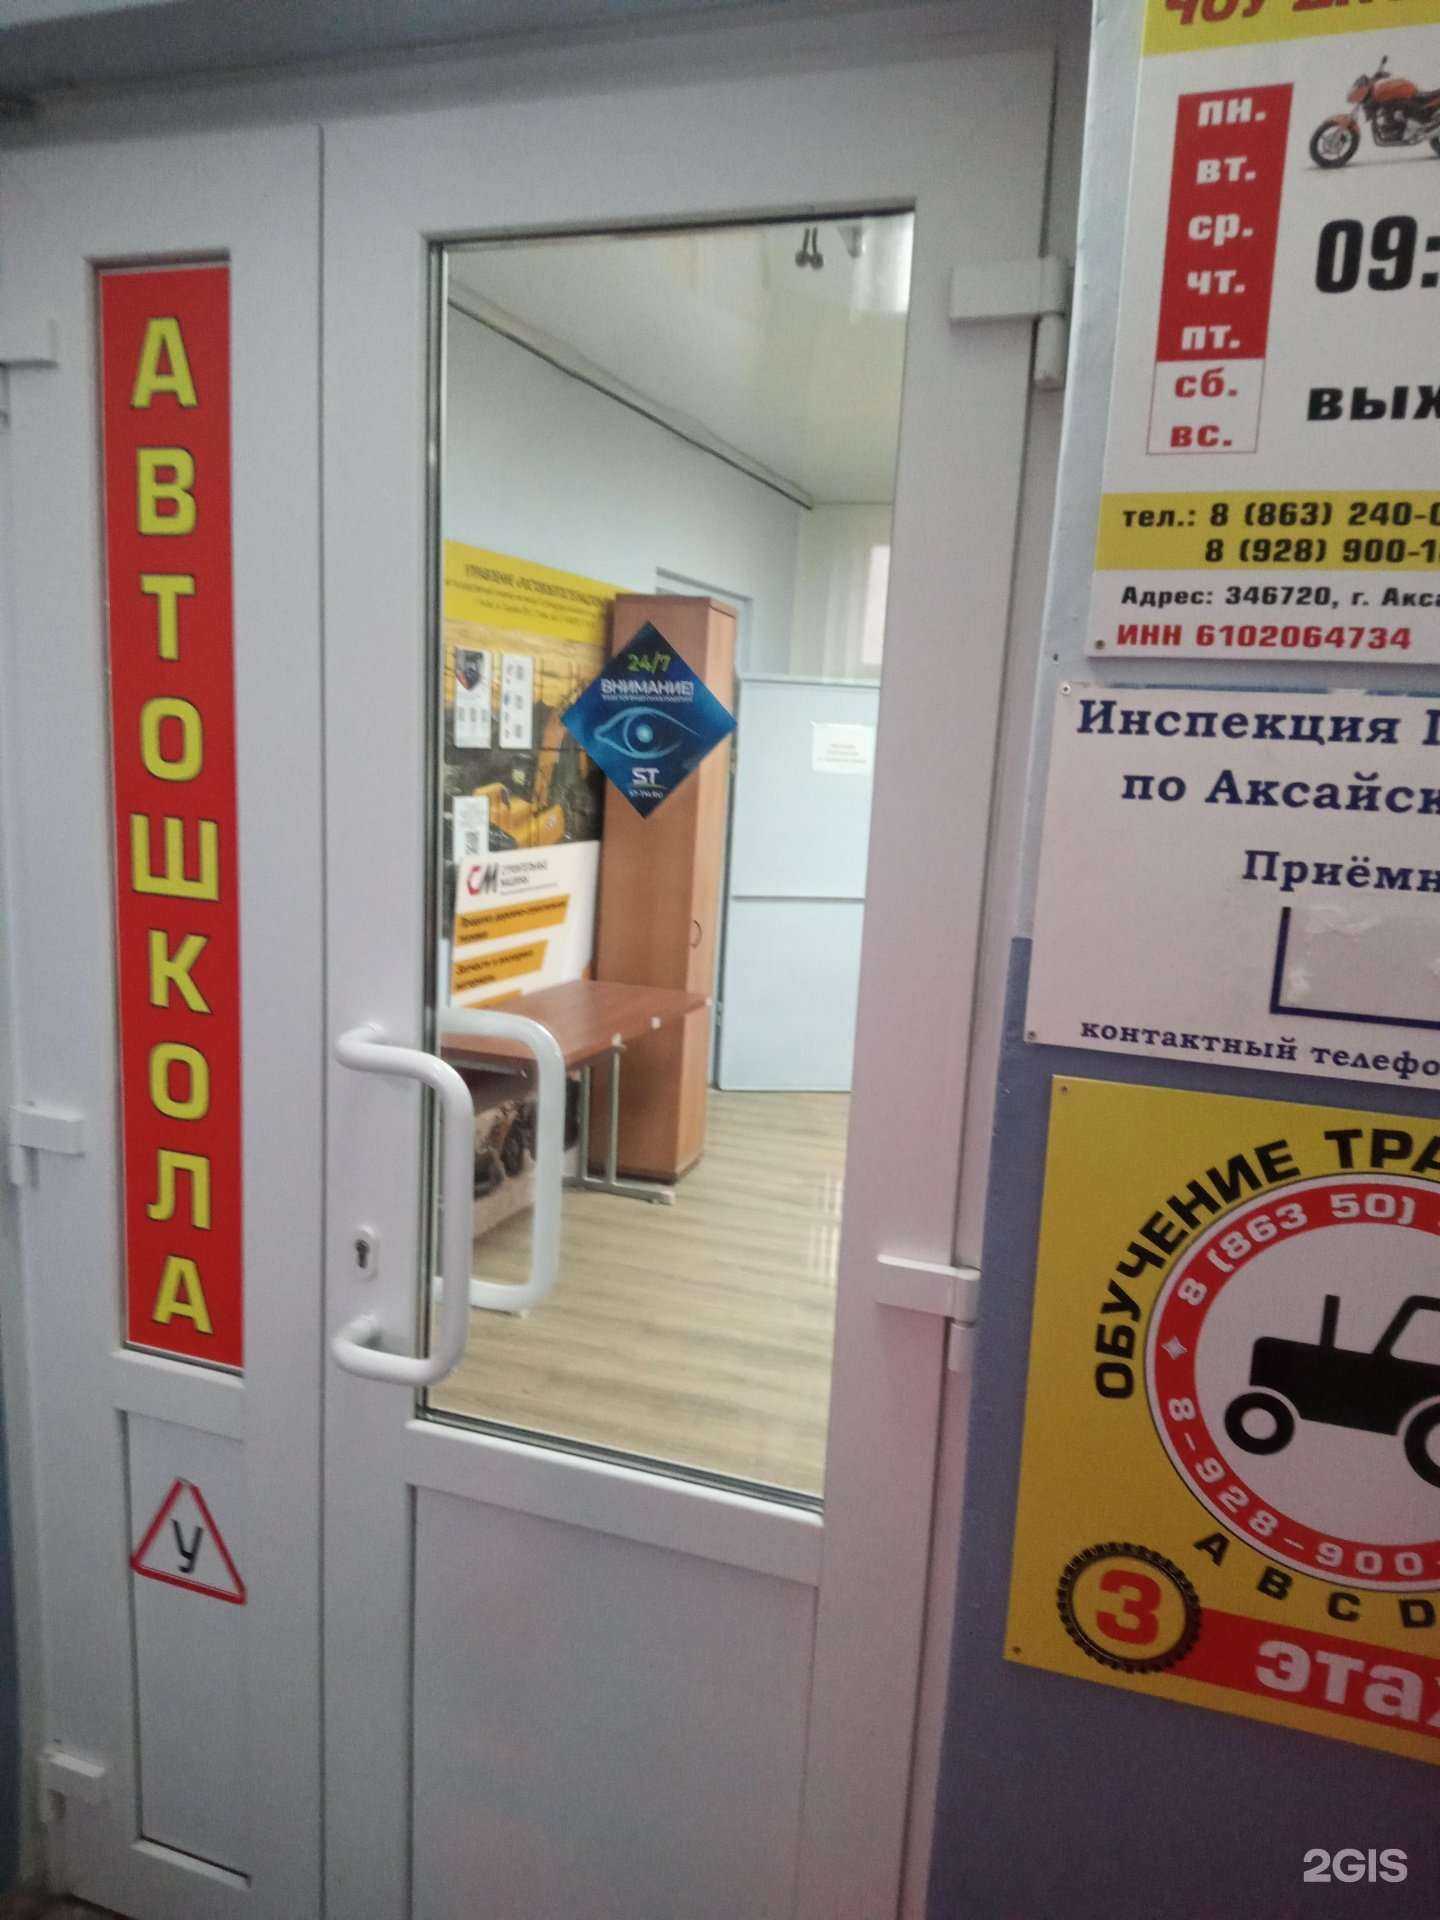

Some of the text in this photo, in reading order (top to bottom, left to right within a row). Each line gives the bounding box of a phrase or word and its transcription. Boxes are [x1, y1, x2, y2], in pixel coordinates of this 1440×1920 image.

[1198, 96, 1267, 127] пн.
[1195, 156, 1257, 184] вт.
[1188, 213, 1254, 247] ср.
[1187, 269, 1246, 295] чт.
[1181, 324, 1241, 351] пт.
[1174, 367, 1238, 398] сб.
[1170, 425, 1233, 448] вс.
[1122, 508, 1196, 529] тел.:
[1209, 502, 1230, 527] 8
[1244, 501, 1333, 527] (863)
[1204, 538, 1440, 563] 8 (928) 900-1
[1120, 586, 1440, 609] Адрес: 346720, г. Акс
[1116, 624, 1412, 650] ИНН 6102064734
[1076, 699, 1402, 745] Инспекция
[1121, 769, 1440, 815] по Аксайск
[127, 316, 220, 1335] АВТОШКОЛА
[1241, 850, 1440, 893] Приёмн
[1080, 1021, 1440, 1080] контактный телефо
[1095, 1139, 1301, 1399] ОБУЧЕНИЕ
[1176, 1278, 1208, 1306] 8
[1167, 1396, 1440, 1577] 8-928-900
[1095, 1569, 1440, 1728] 3 эта
